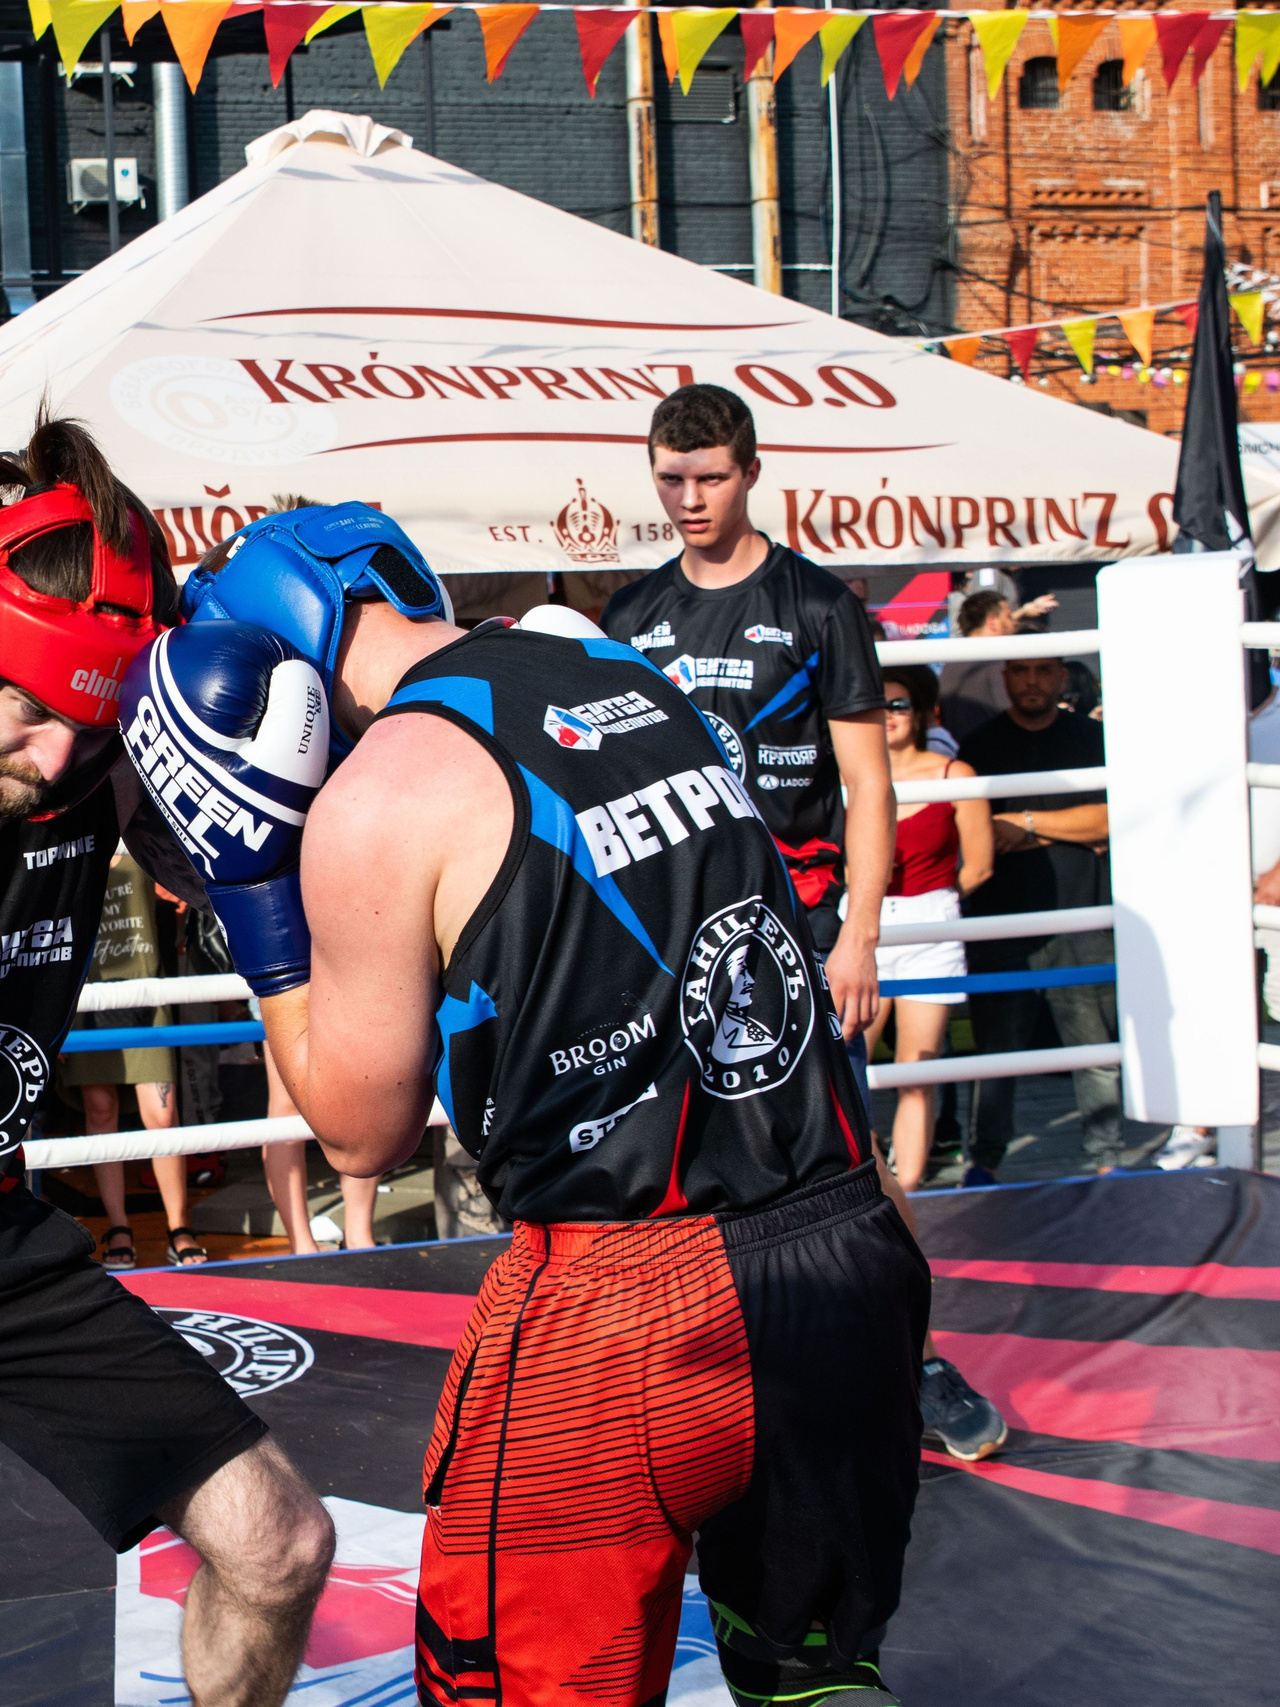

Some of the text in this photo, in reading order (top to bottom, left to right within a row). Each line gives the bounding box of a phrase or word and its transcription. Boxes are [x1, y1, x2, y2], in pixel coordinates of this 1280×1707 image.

[733, 363, 897, 409] 0.0
[488, 523, 674, 543] EST. 158
[780, 477, 1130, 554] KRÓNPRINZ
[695, 658, 753, 678] БИТВА
[297, 686, 316, 755] UNIQUE
[568, 690, 656, 724] БИТВА
[127, 716, 220, 859] HILL
[137, 695, 274, 852] GREEN
[549, 1013, 657, 1076] BROOM
[593, 1056, 628, 1076] GIN
